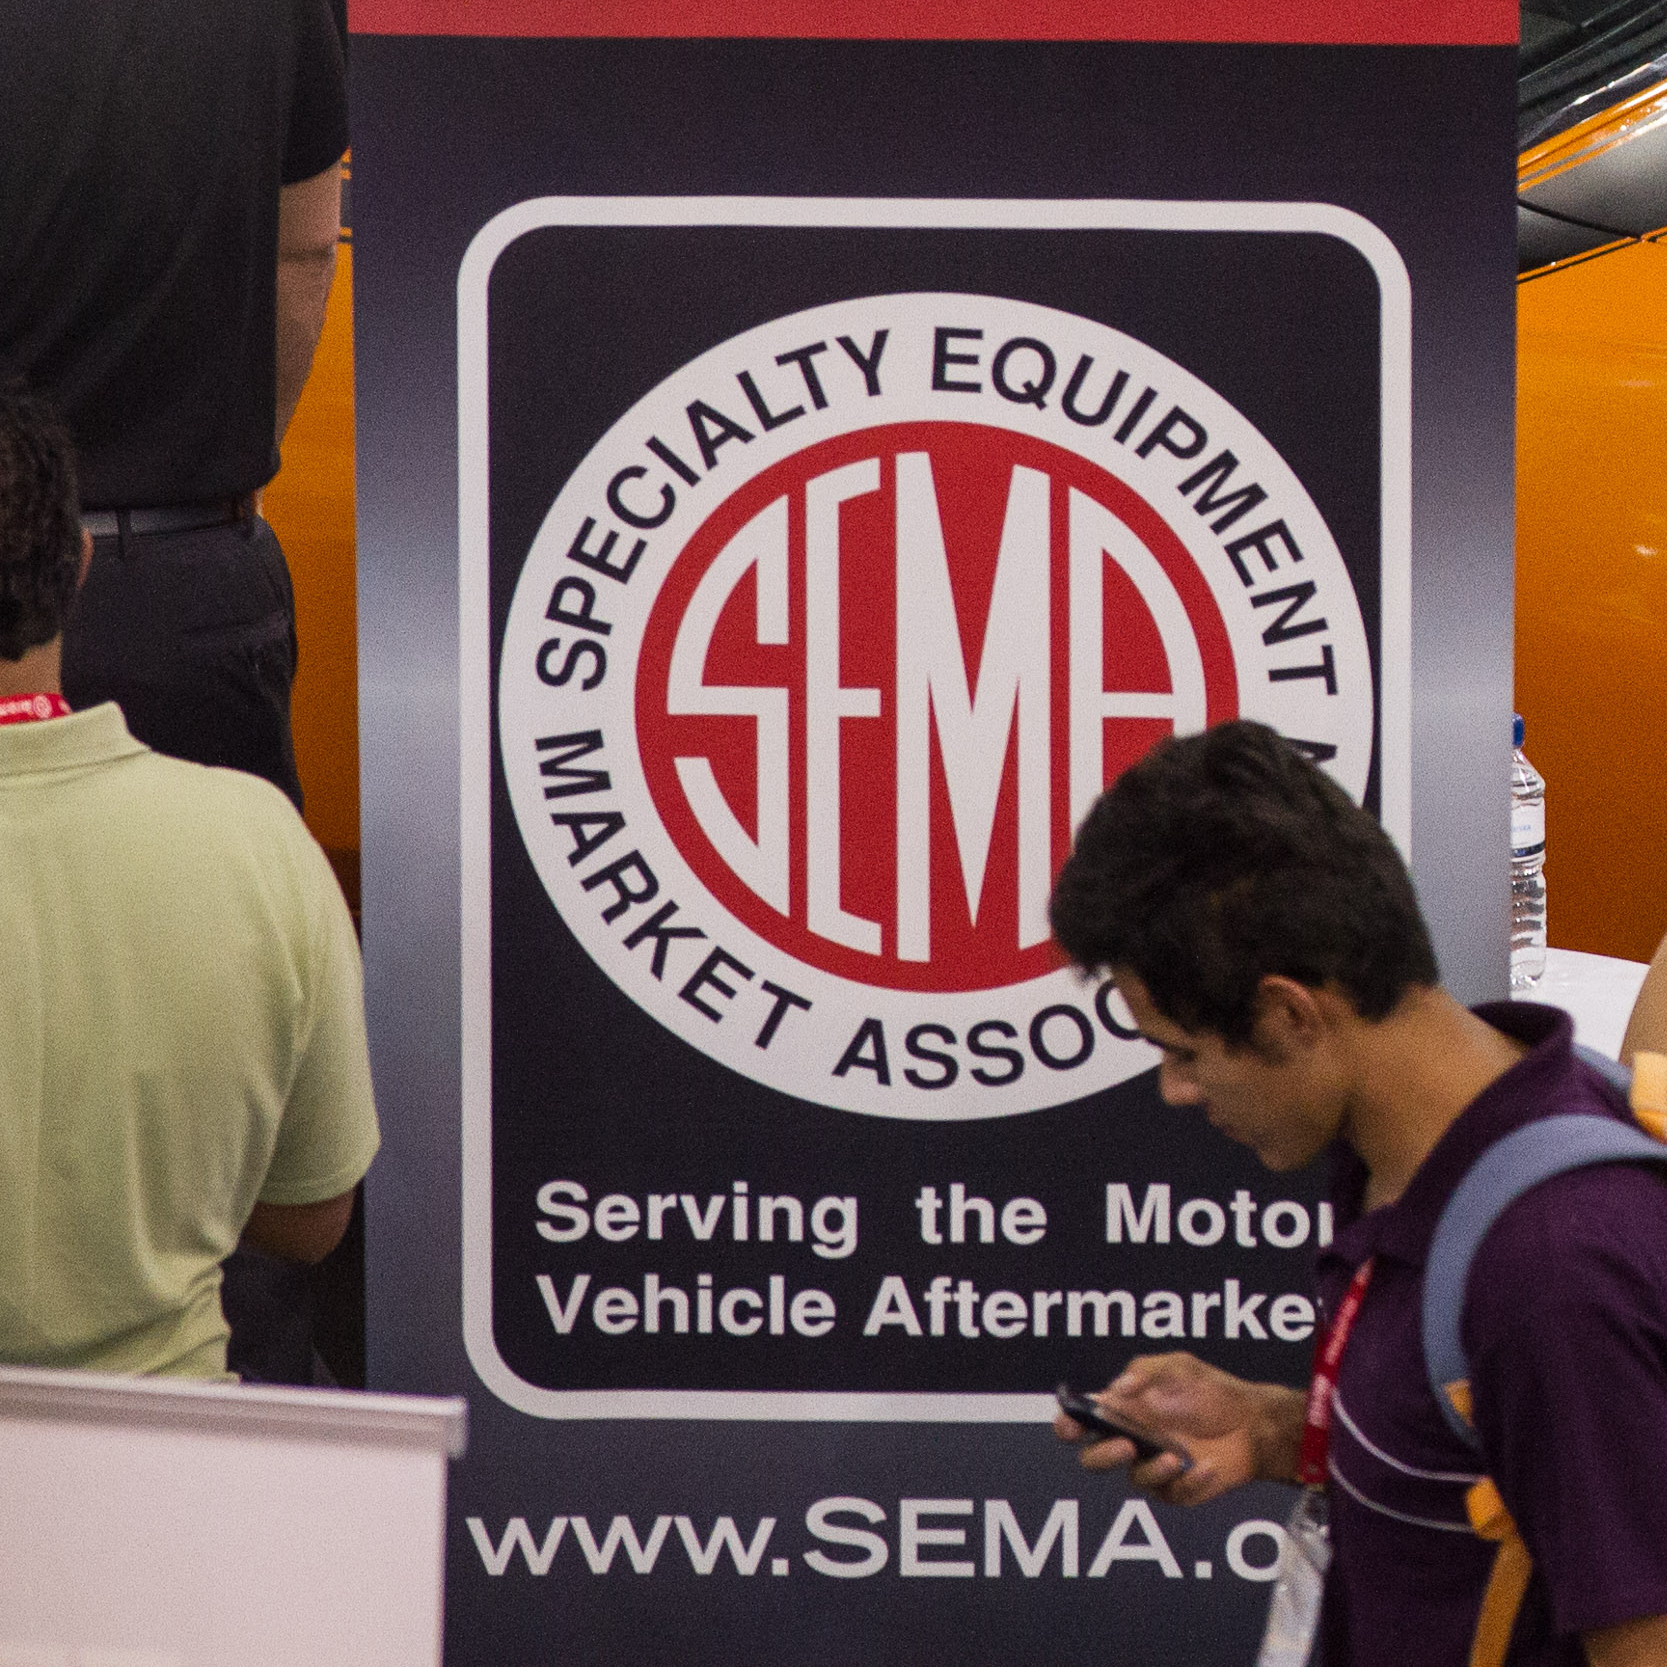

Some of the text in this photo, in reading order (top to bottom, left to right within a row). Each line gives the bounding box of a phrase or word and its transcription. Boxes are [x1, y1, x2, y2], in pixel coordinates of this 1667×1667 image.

[535, 325, 1339, 698] SPECIALTY EQUIPMENT
[666, 450, 1207, 963] SEMA
[535, 727, 813, 1052] MARKET
[536, 1180, 859, 1258] Serving
[915, 1183, 1048, 1246] the
[536, 1274, 837, 1336] Vehicle
[863, 1275, 1323, 1342] Aftermarke
[466, 1495, 1285, 1582] www.SEMA.o
